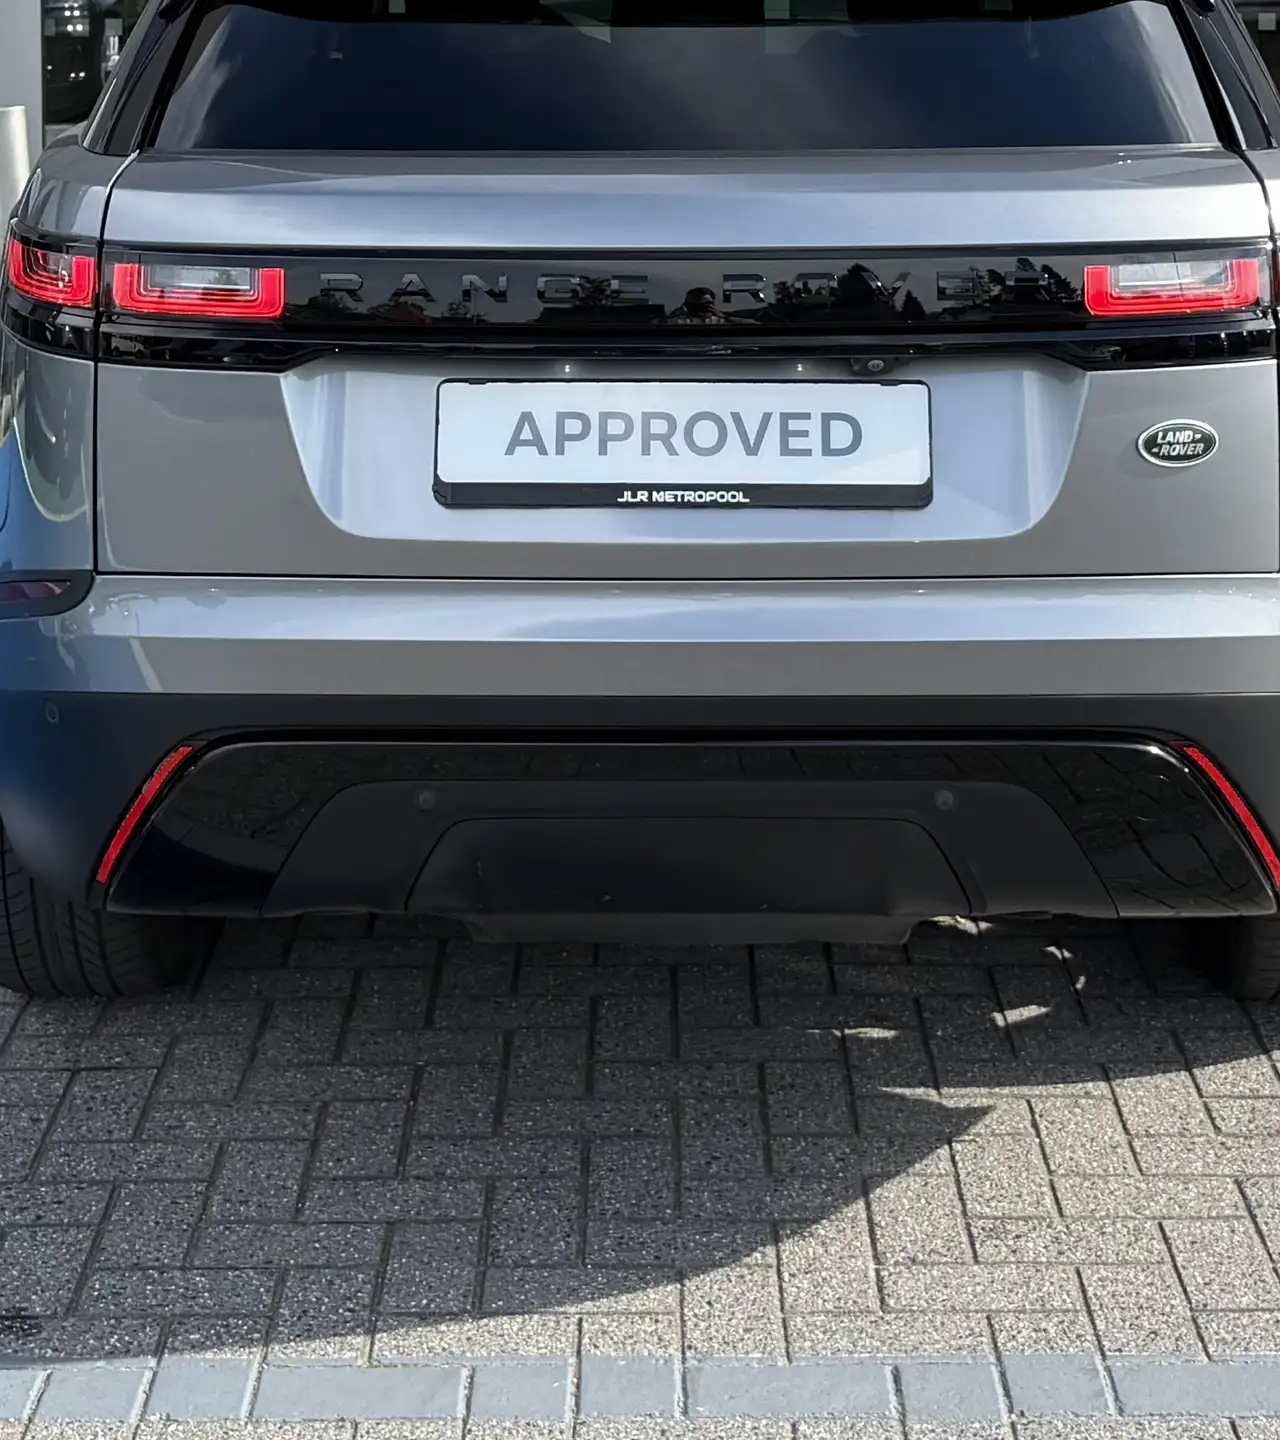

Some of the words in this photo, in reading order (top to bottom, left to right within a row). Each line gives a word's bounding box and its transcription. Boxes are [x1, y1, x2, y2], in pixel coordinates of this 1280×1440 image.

[320, 272, 649, 305] RANGE
[722, 270, 1048, 303] ROVER
[504, 411, 863, 457] APPROVED
[1156, 430, 1194, 444] LAND
[1159, 442, 1205, 457] ROVER
[617, 491, 649, 503] JLR
[652, 491, 751, 503] METROPOOL
